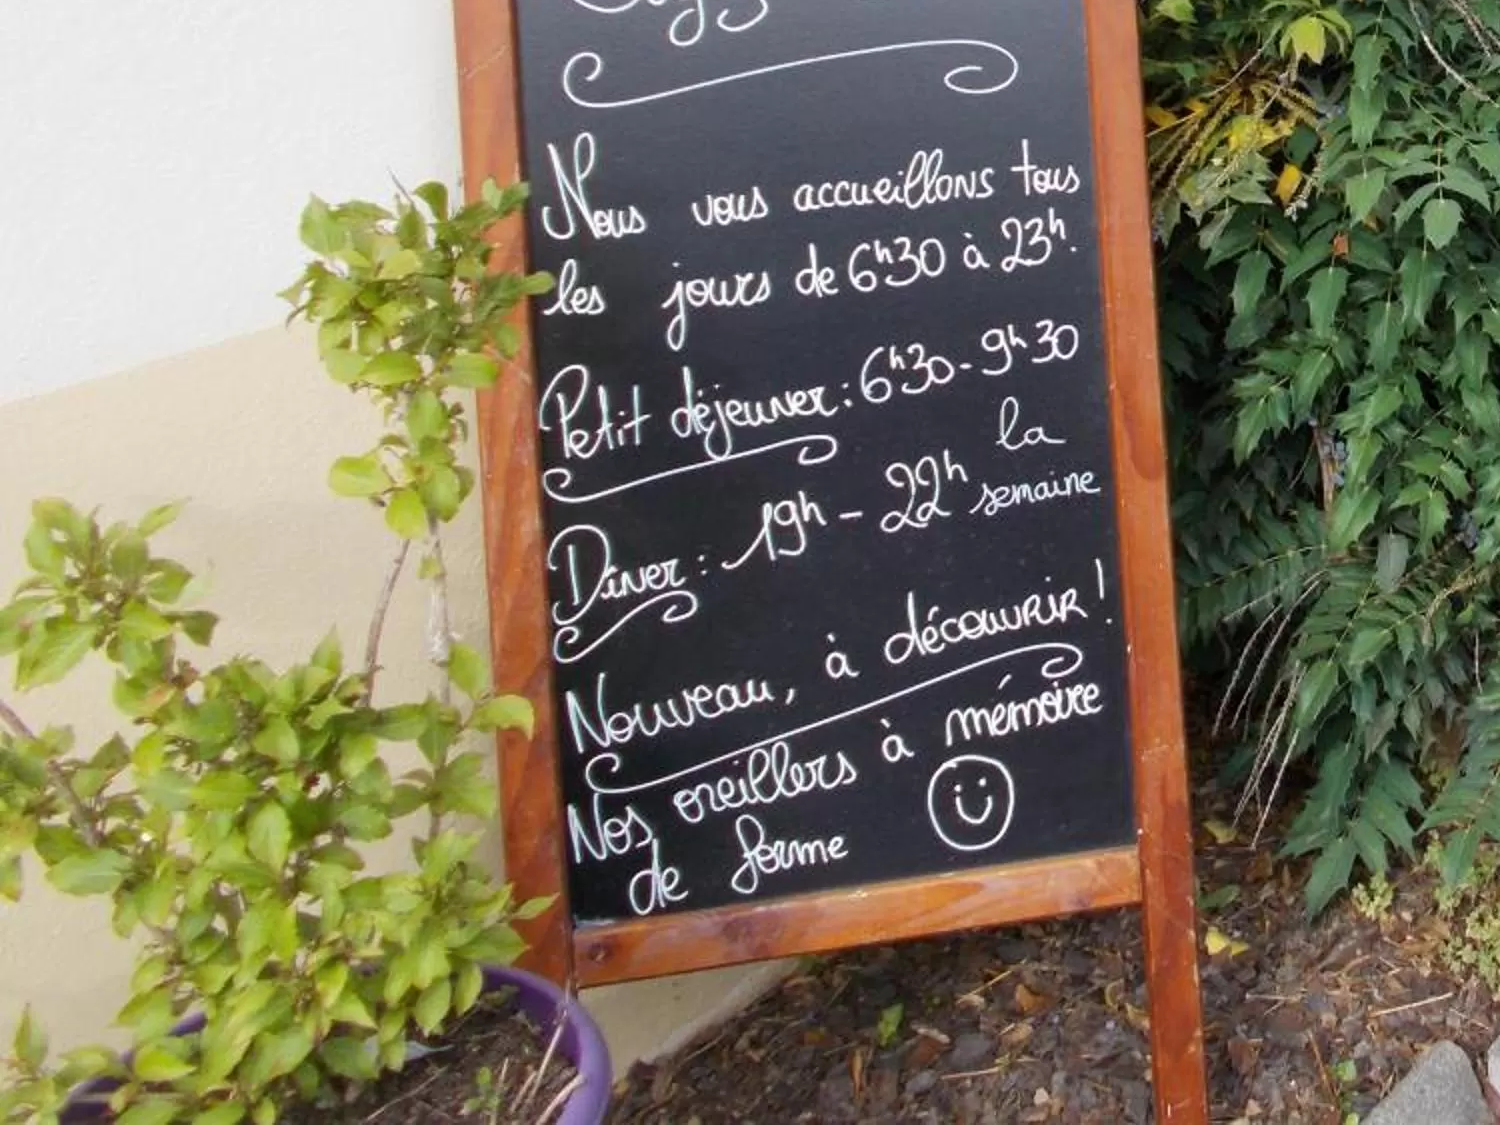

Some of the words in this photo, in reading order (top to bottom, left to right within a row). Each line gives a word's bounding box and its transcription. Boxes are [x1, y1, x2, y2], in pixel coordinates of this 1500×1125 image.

[542, 132, 647, 240] Nous
[692, 185, 769, 226] vous
[793, 148, 994, 212] accueillons
[1011, 138, 1081, 197] tous
[543, 258, 606, 315] les
[661, 262, 771, 351] jours
[794, 243, 839, 297] de
[848, 237, 946, 291] 6h30
[963, 232, 990, 268] à
[539, 364, 651, 459] Petit
[996, 397, 1067, 451] la
[721, 490, 827, 569] 19h
[880, 450, 969, 535] 22h
[969, 468, 1100, 517] semaine
[566, 672, 798, 753] Nouveau,
[825, 633, 860, 681] à
[567, 795, 653, 863] Nos
[673, 742, 858, 823] oreillers
[881, 718, 915, 765] à
[944, 674, 1103, 746] mémoire
[629, 837, 689, 916] de
[731, 815, 848, 894] forme
